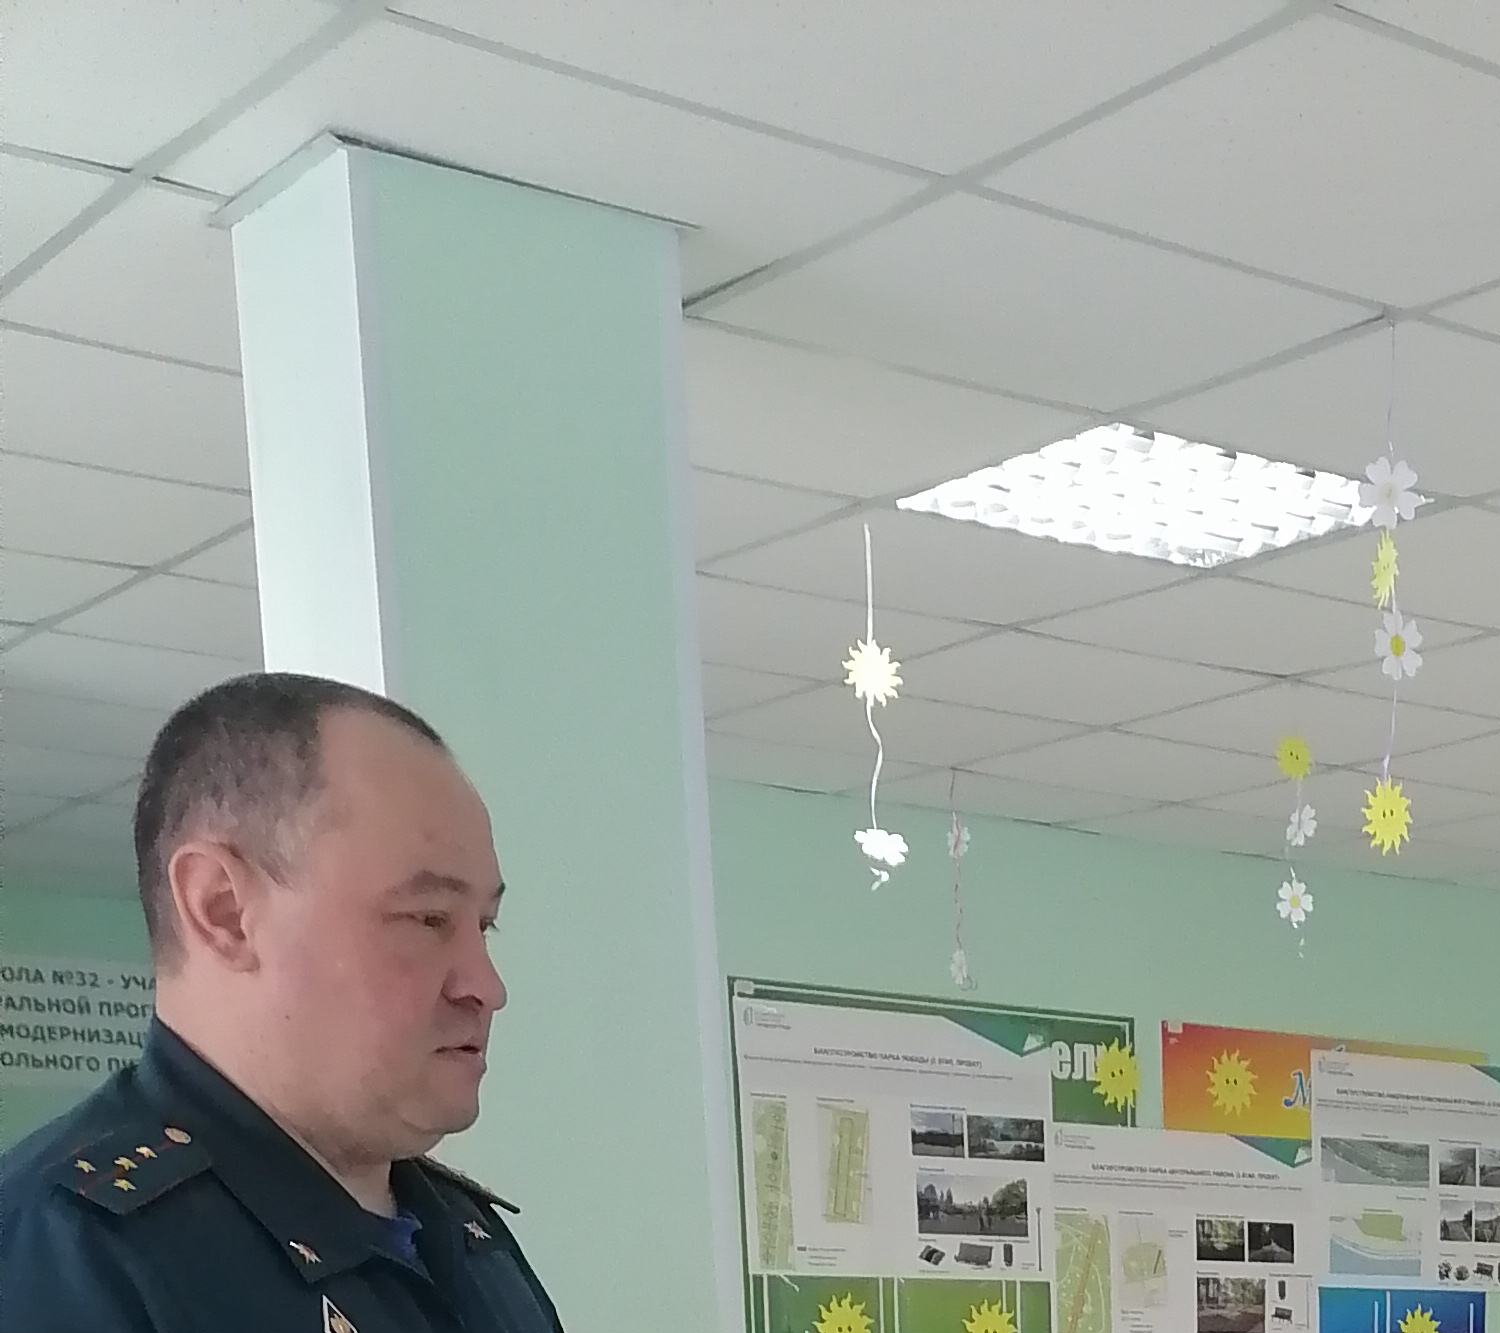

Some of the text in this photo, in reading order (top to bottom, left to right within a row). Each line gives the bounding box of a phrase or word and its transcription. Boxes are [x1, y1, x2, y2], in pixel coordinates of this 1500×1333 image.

[52, 969, 101, 988] №32
[0, 1023, 146, 1049] МОДЕРНИЗАЦ
[0, 1051, 100, 1072] ОЛЬНОГО
[1051, 1040, 1104, 1081] ел
